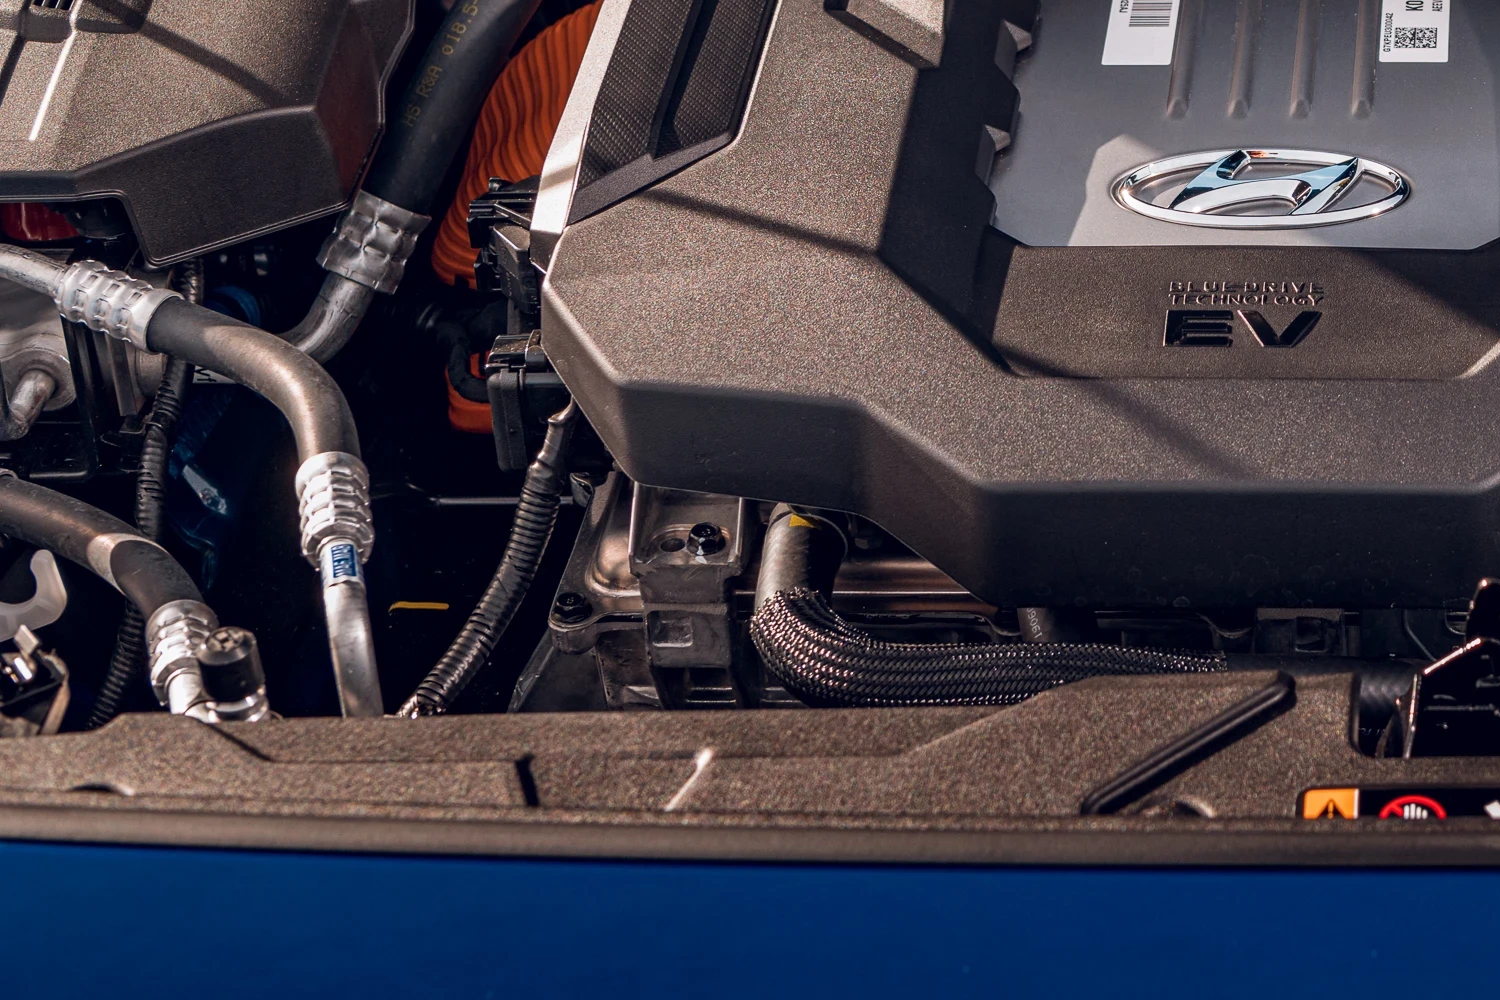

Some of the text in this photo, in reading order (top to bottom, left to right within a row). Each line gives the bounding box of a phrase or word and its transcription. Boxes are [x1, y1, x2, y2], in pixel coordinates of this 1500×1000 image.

[416, 65, 443, 98] R&A
[402, 105, 421, 128] HS
[1167, 294, 1325, 306] TECHNOLOGY
[1163, 309, 1323, 347] EV
